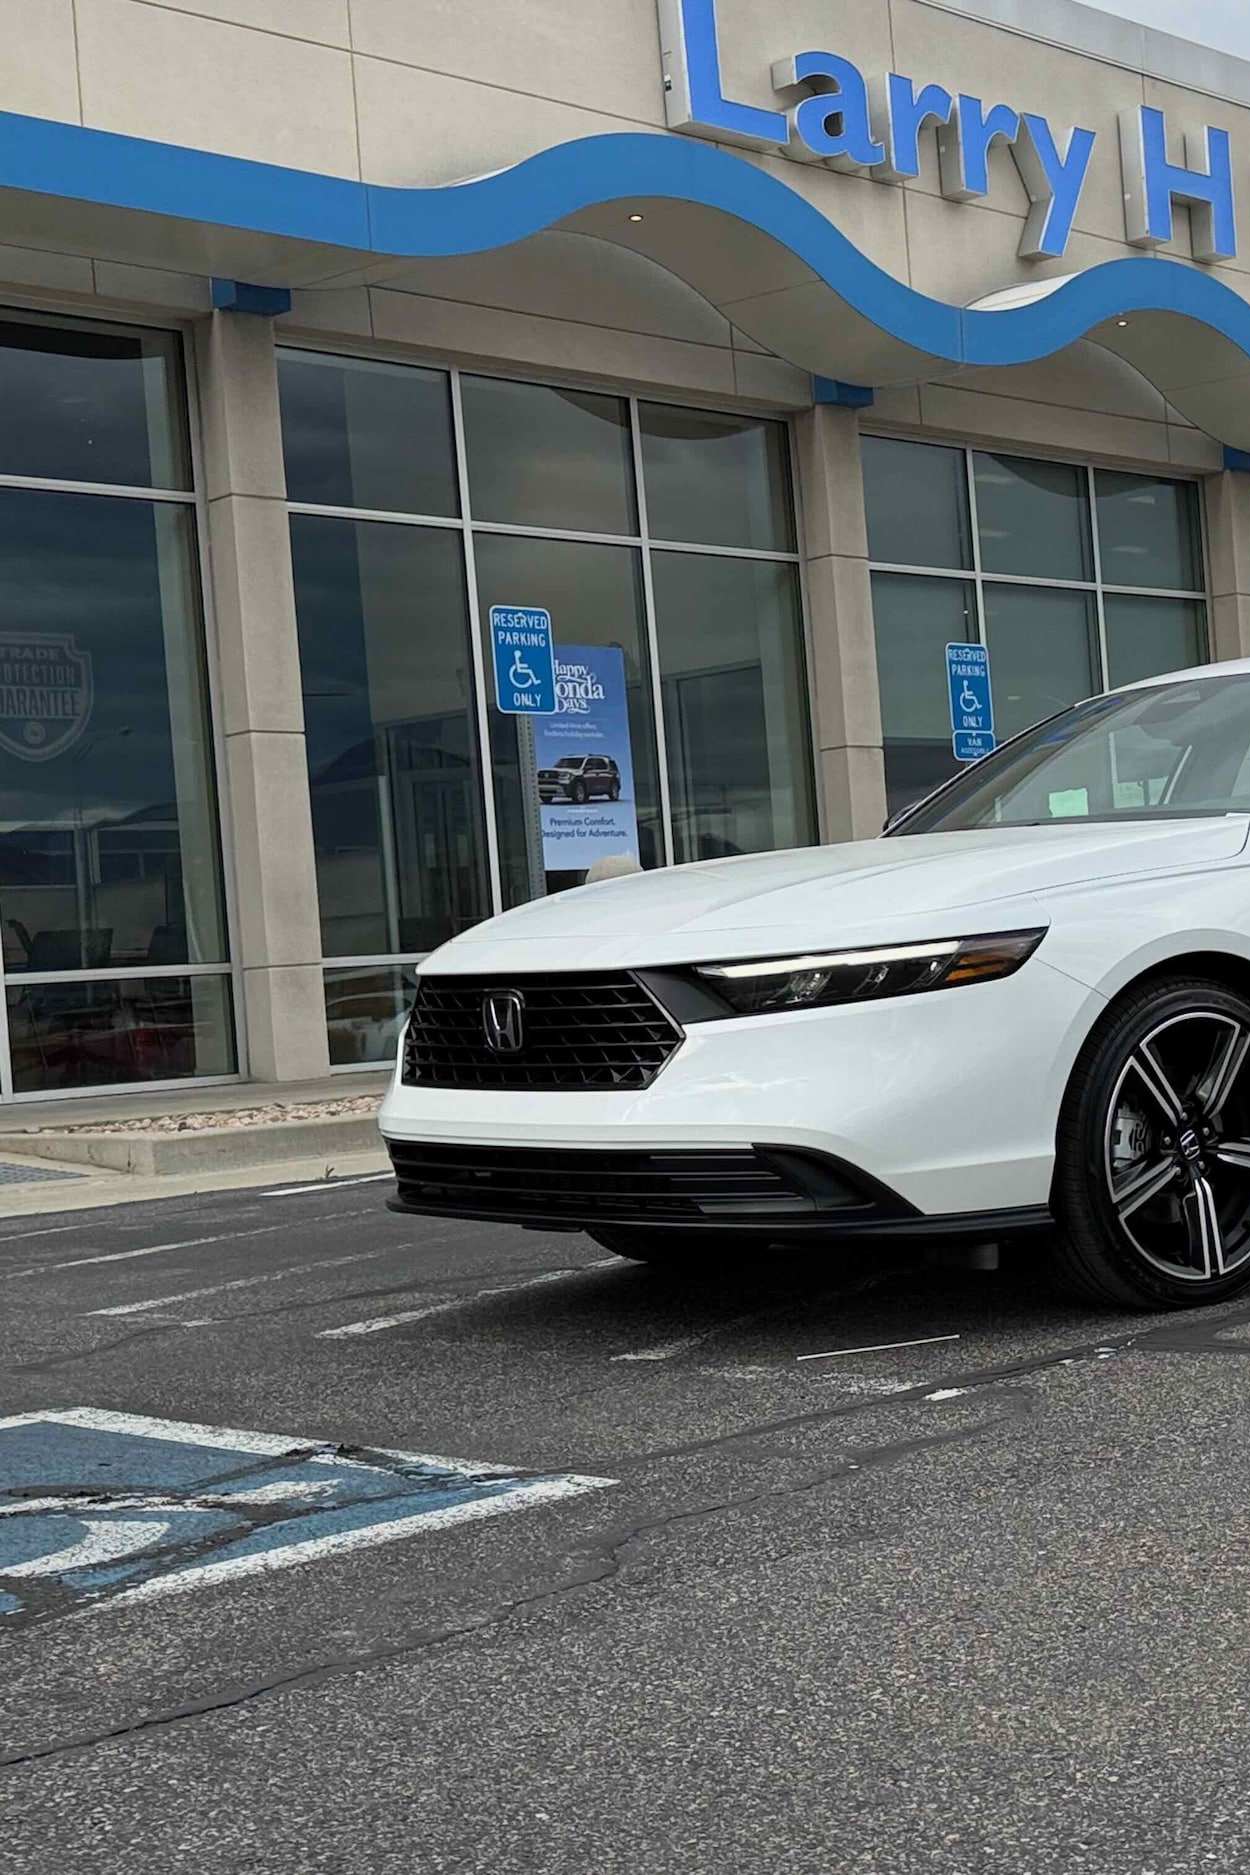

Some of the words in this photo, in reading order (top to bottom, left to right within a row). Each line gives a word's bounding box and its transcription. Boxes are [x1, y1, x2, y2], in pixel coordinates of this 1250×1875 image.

[674, 0, 1095, 260] Larry
[1128, 105, 1236, 262] H
[493, 612, 548, 630] RESERVED
[498, 630, 546, 647] PARKING
[948, 648, 986, 662] RESERVED
[0, 664, 75, 686] OTECTION
[952, 664, 986, 676] PARKING
[556, 673, 605, 700] onda
[513, 691, 541, 707] ONLY
[962, 715, 982, 728] ONLY
[550, 817, 583, 827] Premium
[576, 828, 587, 837] for
